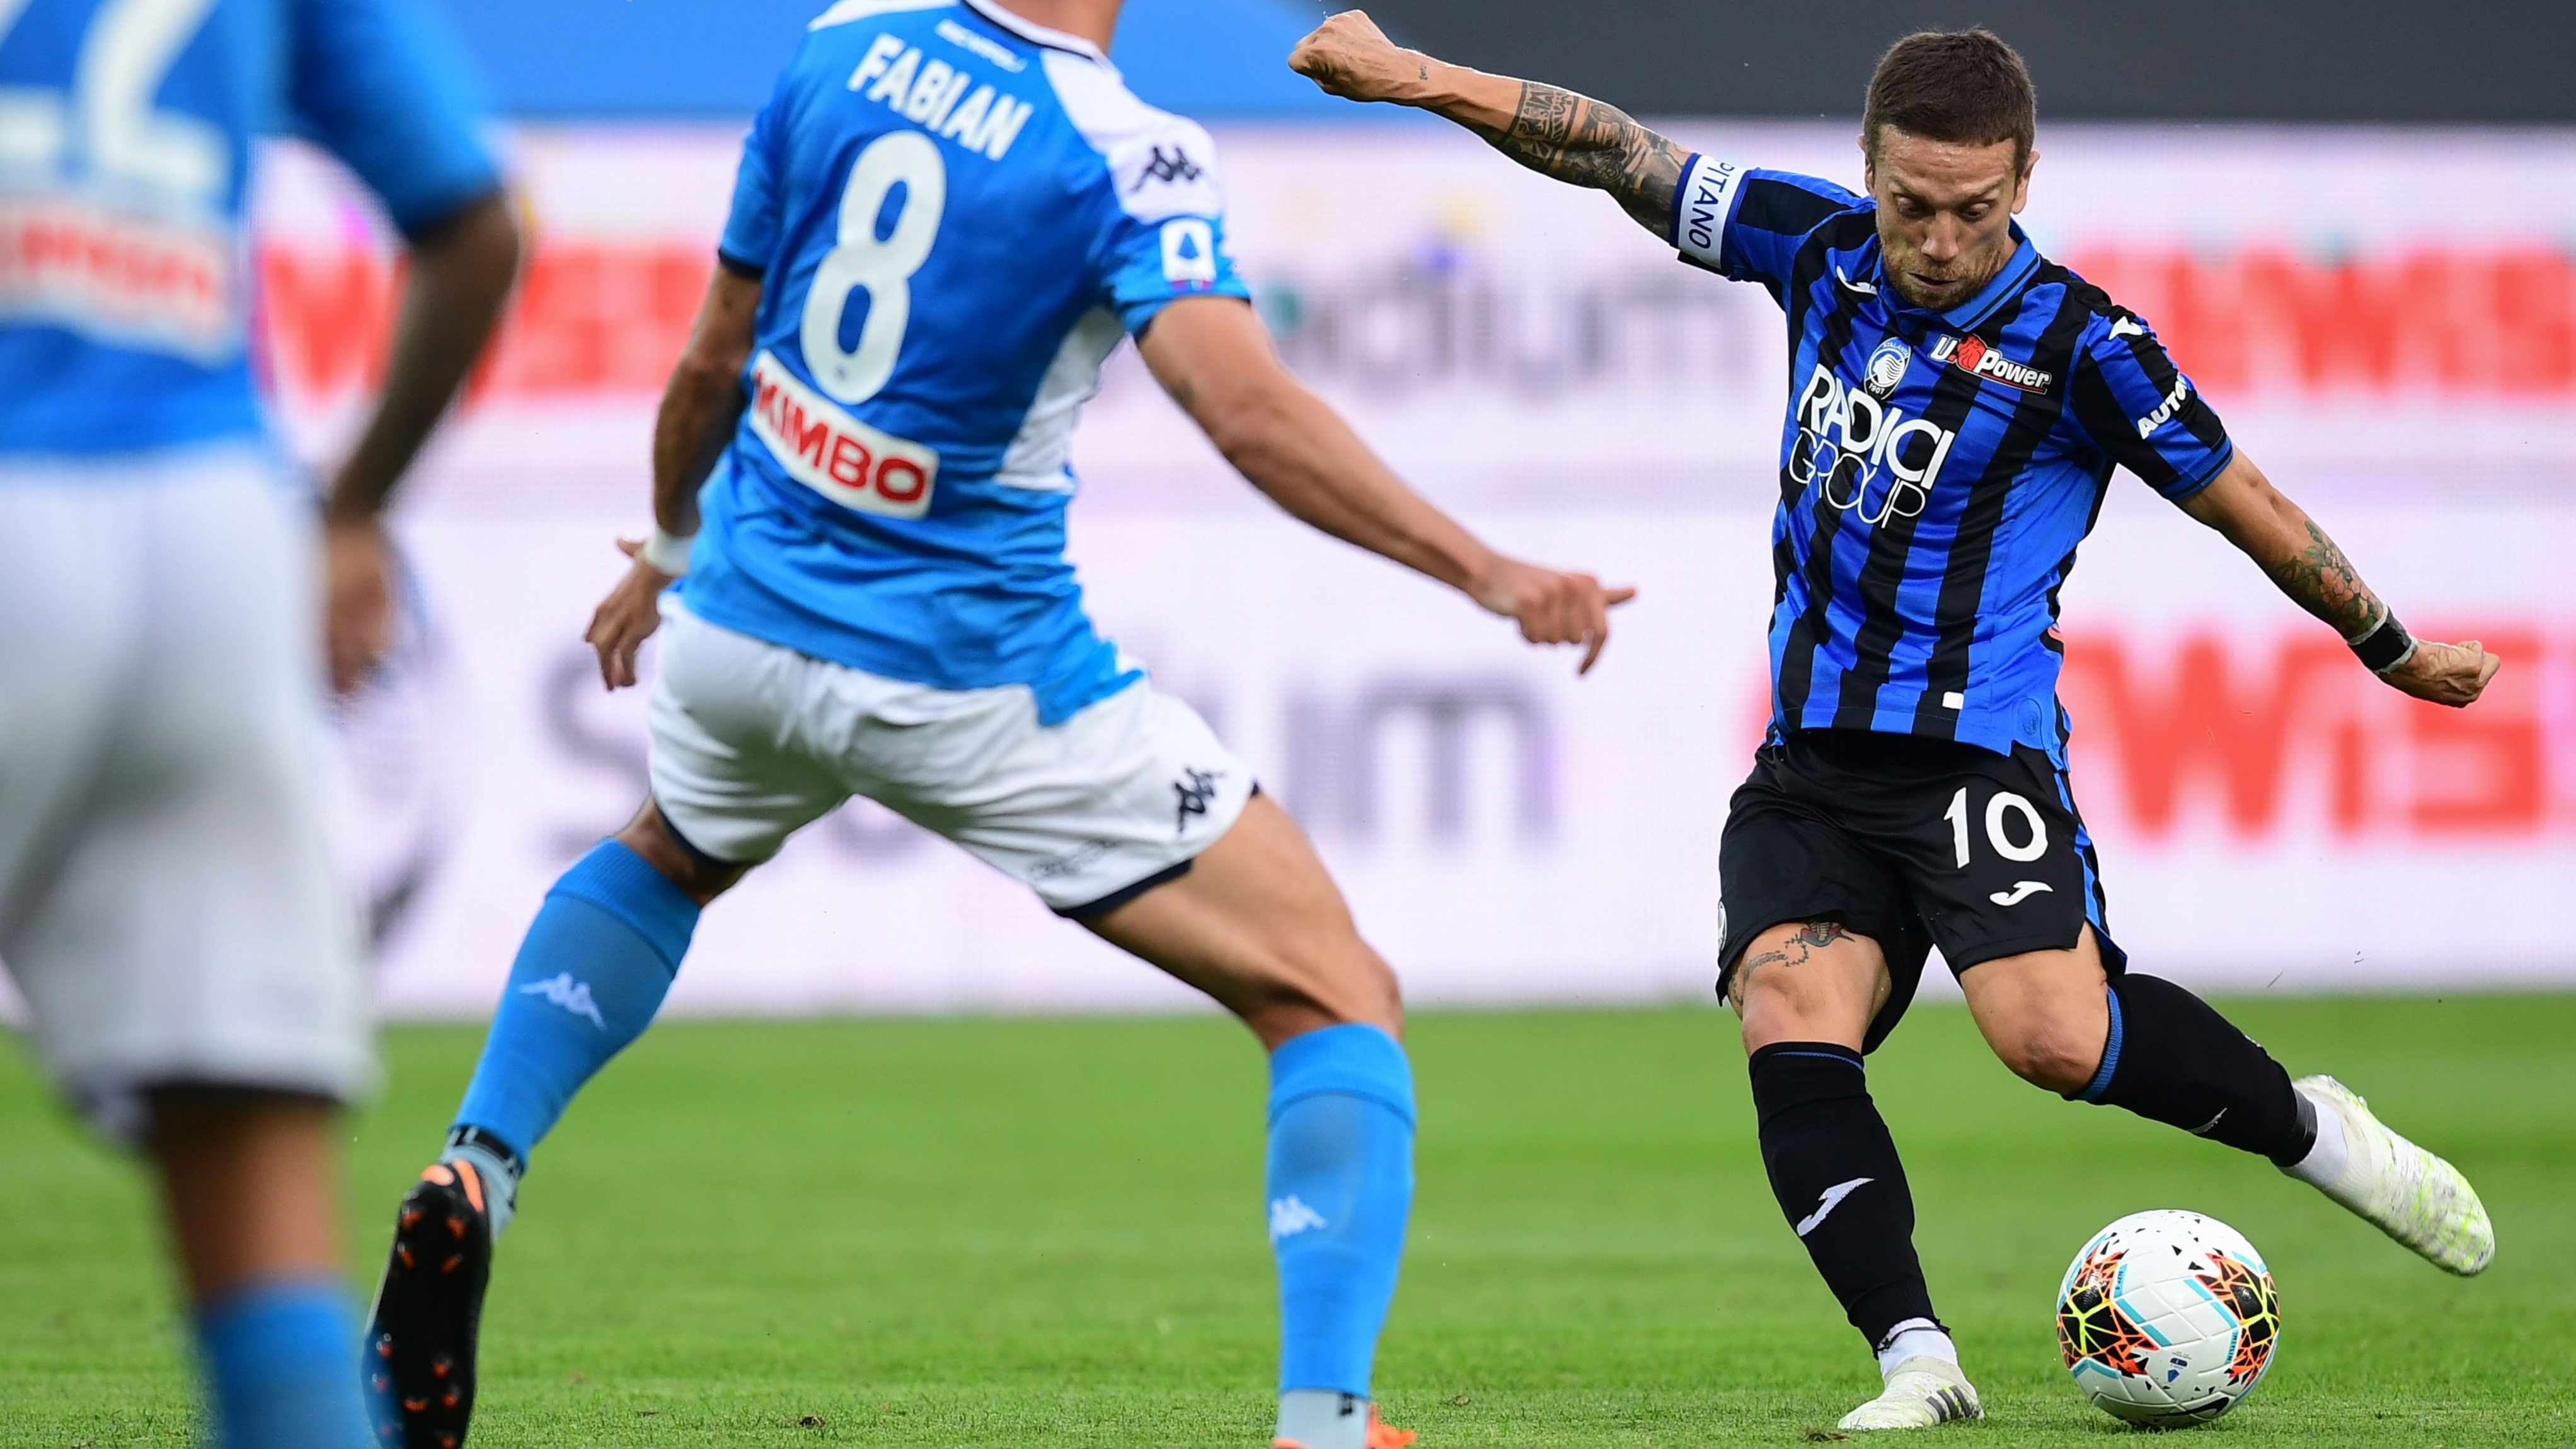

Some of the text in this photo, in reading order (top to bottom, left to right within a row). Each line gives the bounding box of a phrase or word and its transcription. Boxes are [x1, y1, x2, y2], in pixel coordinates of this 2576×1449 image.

[848, 33, 1032, 161] FABIAN
[799, 129, 946, 405] 8
[1868, 383, 1885, 395] 1907
[1973, 349, 2049, 388] Power
[754, 371, 926, 502] KIMBO
[1789, 427, 1926, 529] GROUP
[1797, 363, 1955, 490] RADICI
[1943, 787, 2048, 869] 10
